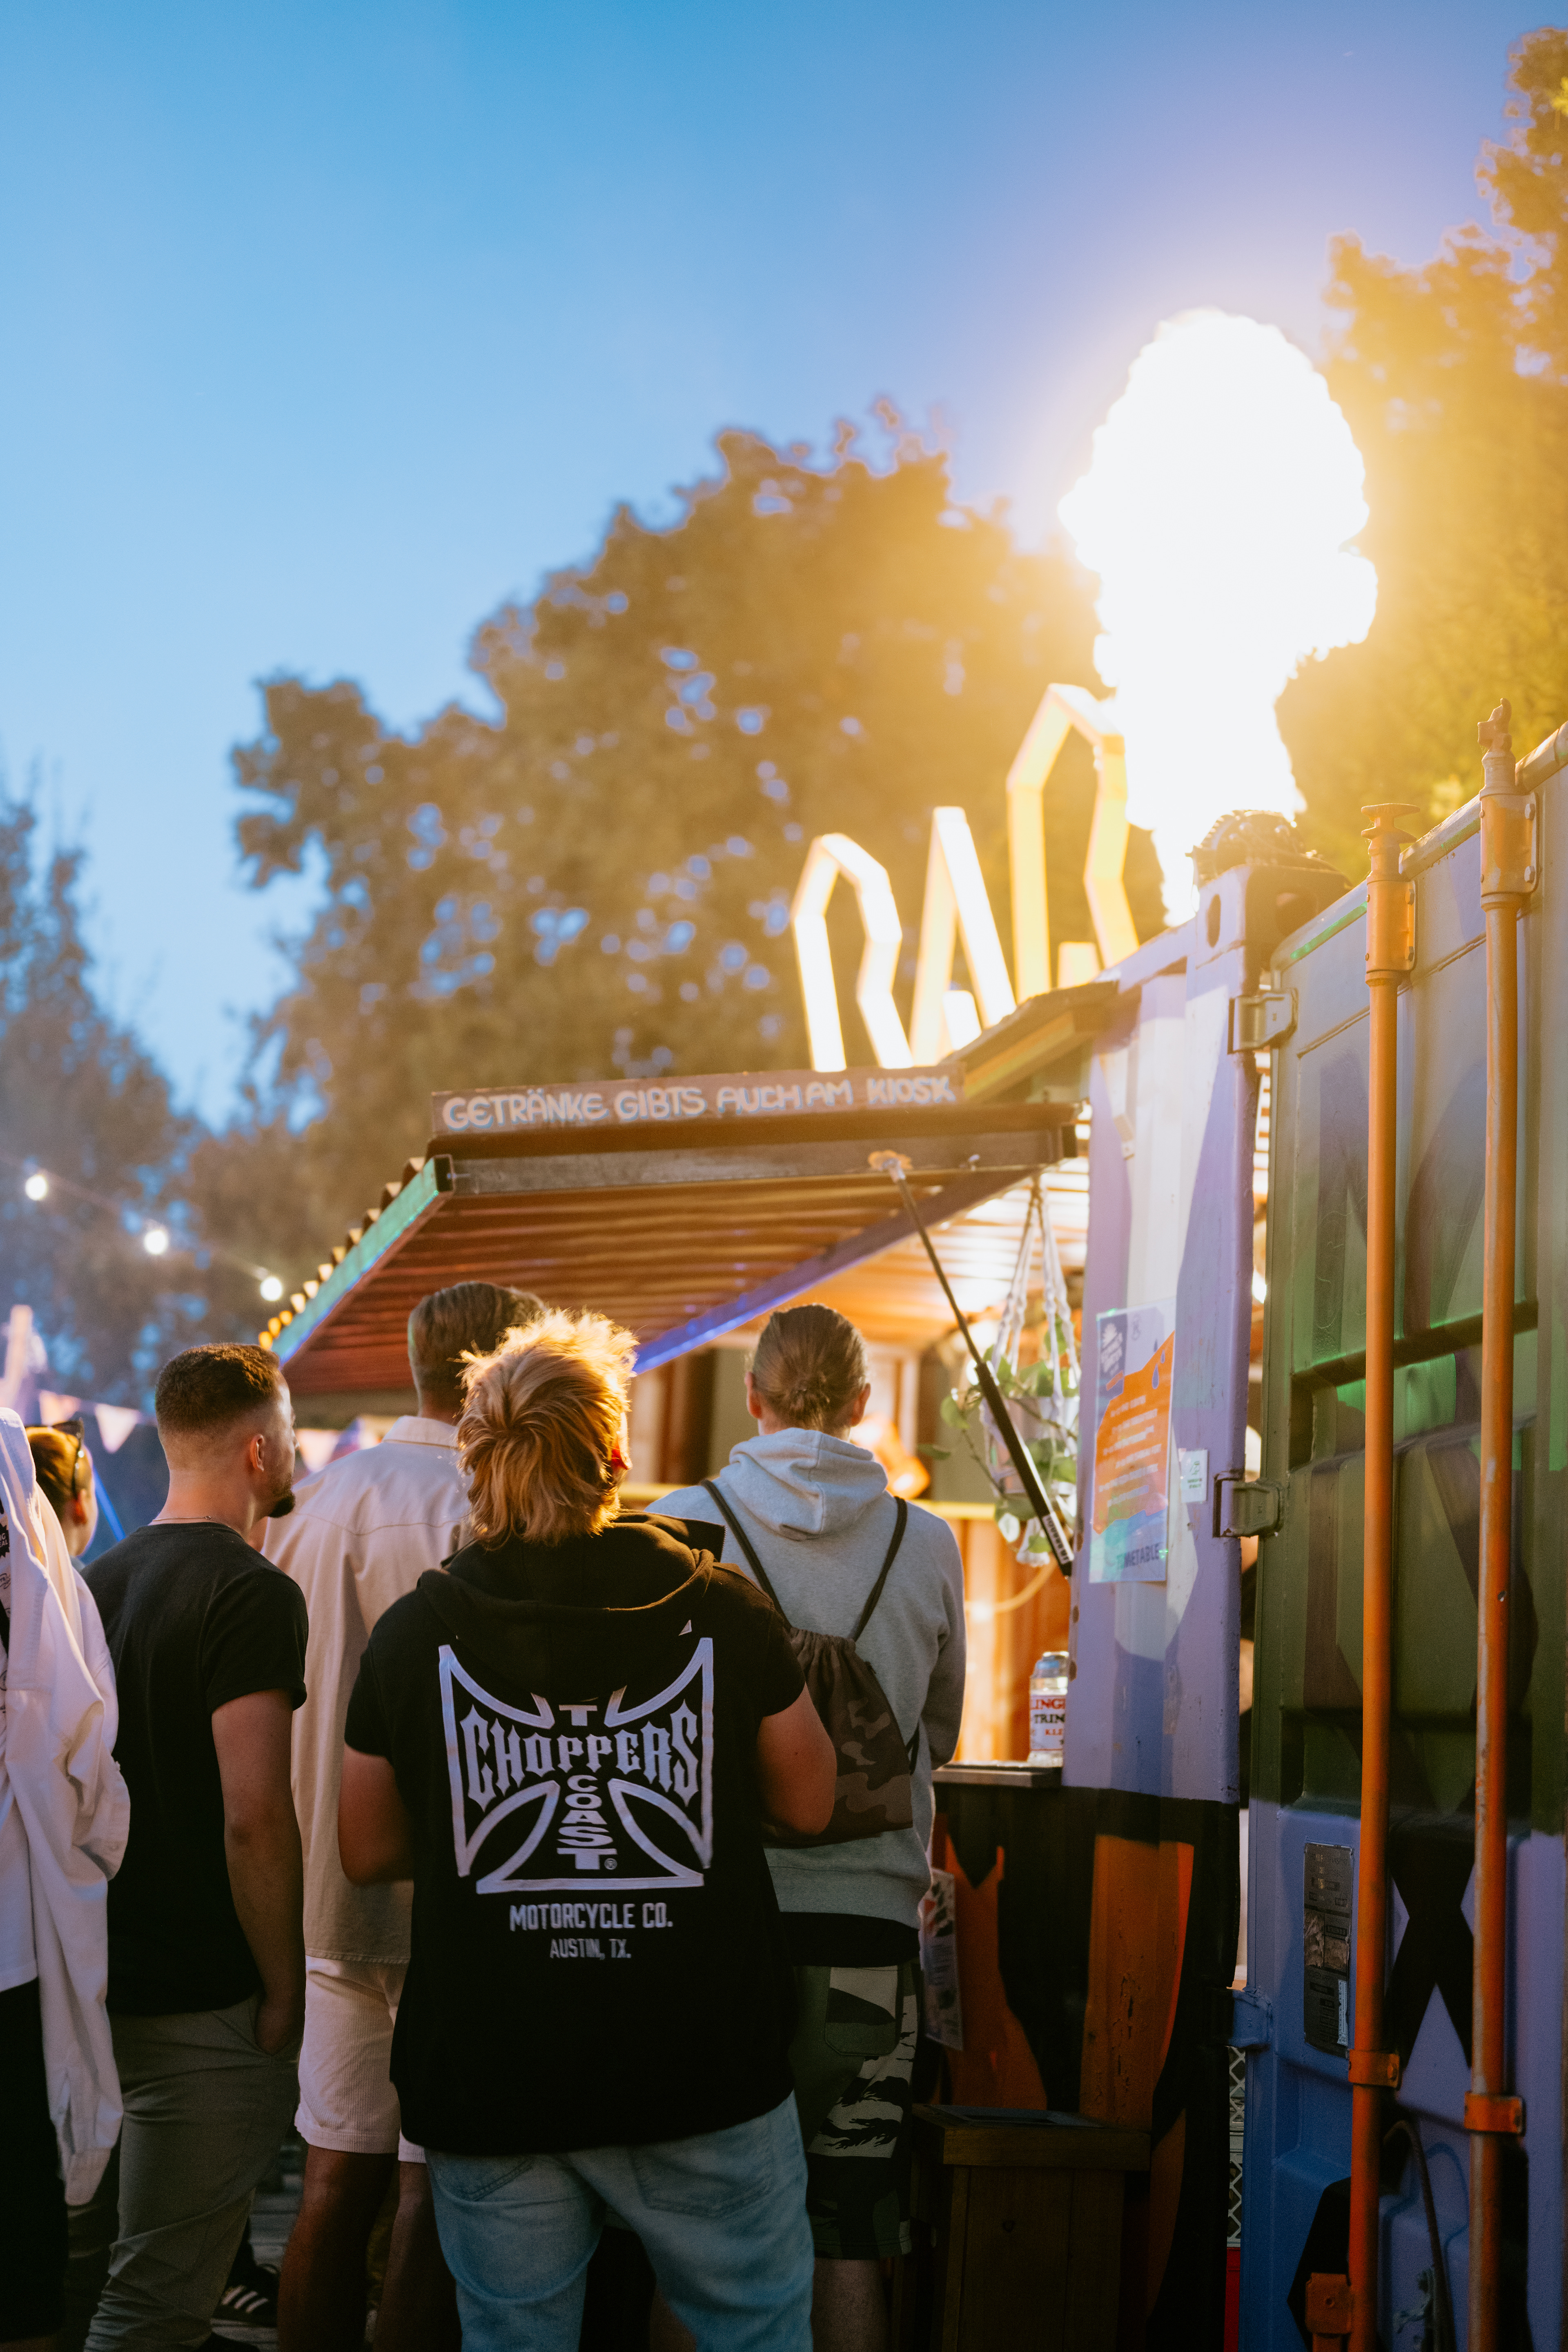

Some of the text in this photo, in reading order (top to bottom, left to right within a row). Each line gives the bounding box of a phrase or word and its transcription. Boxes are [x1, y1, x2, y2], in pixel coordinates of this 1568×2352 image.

[443, 1076, 956, 1131] GETRÄNKE GIBTS AUCH AM KIOSK
[460, 1699, 699, 1813] CHOPPERS
[510, 1902, 673, 1931] MOTORCYCLE CO.
[550, 1938, 632, 1960] AUSTIN, TX.
